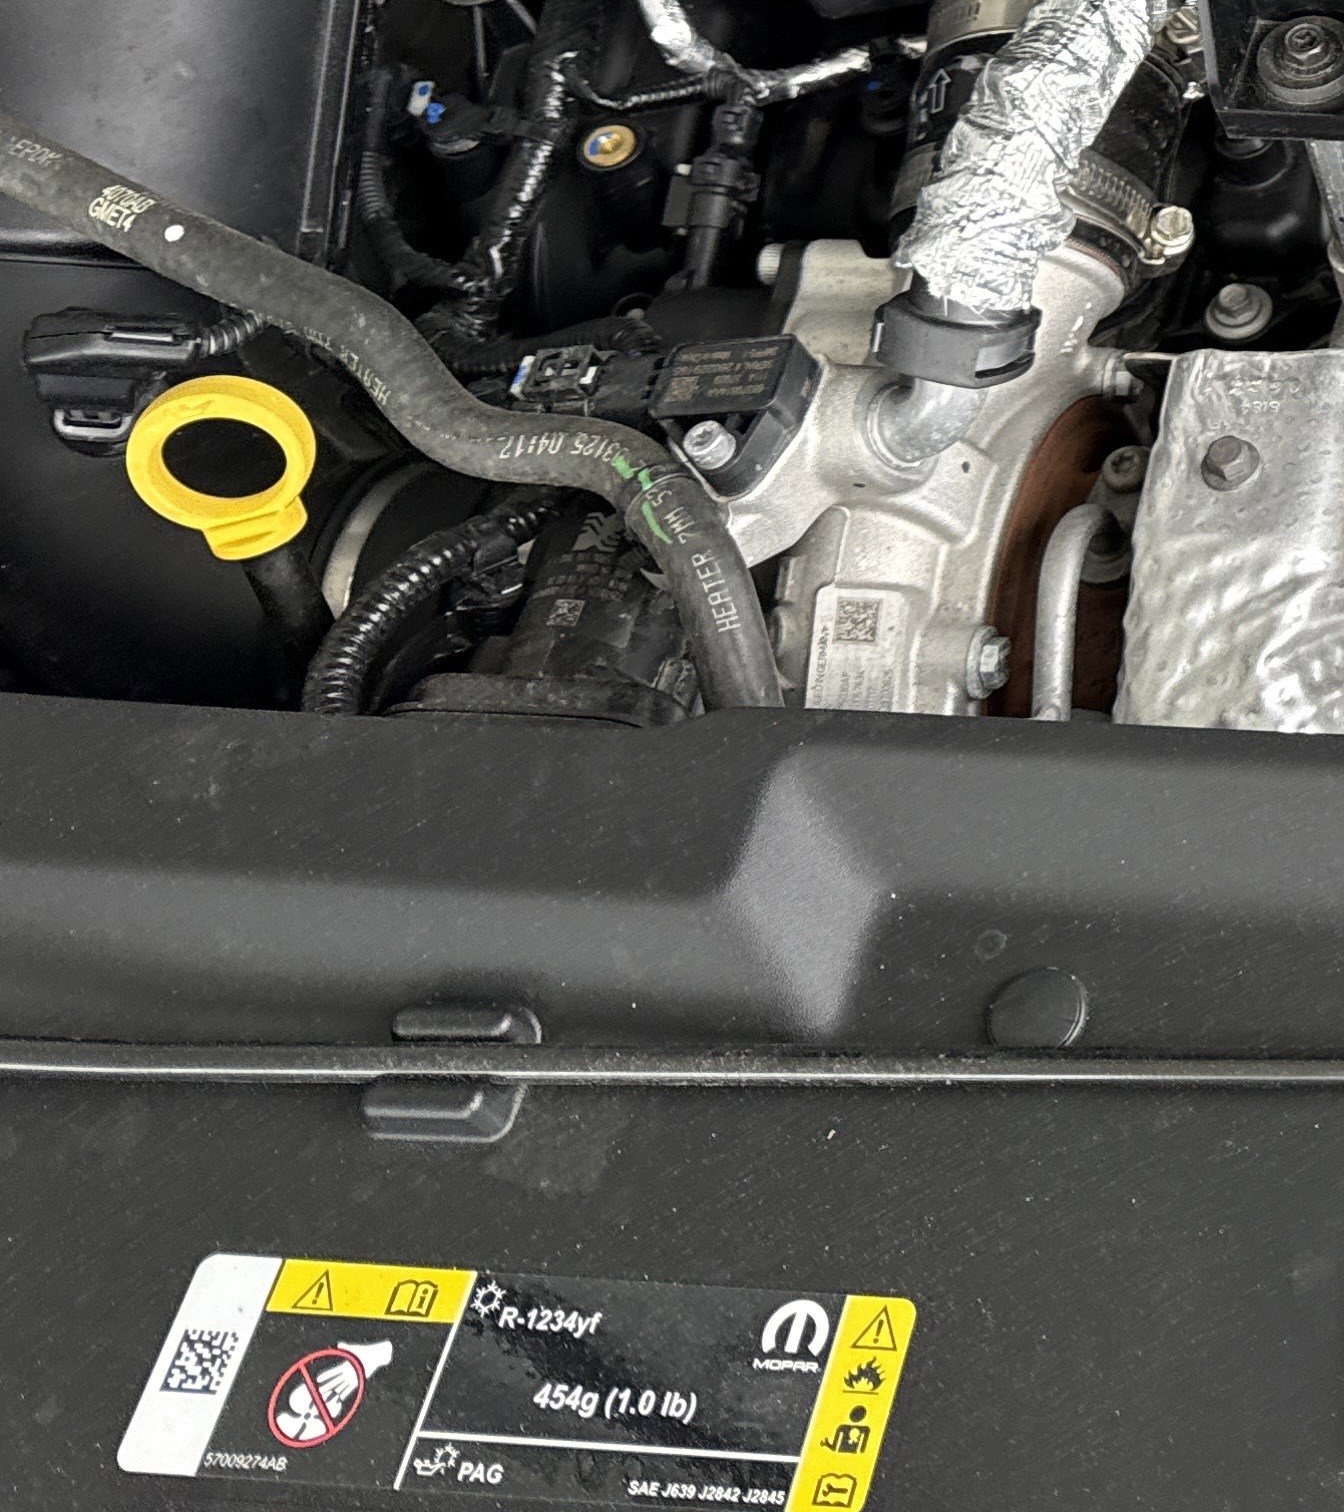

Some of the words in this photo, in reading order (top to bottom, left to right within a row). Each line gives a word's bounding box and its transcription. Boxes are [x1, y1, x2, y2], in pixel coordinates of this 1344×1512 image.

[690, 548, 742, 633] HEATER
[498, 1306, 602, 1339] R-1234yf
[752, 1357, 819, 1373] MOPAR
[533, 1383, 600, 1418] 454g
[603, 1387, 657, 1420] (1.0
[661, 1390, 697, 1425] lb)
[203, 1452, 288, 1472] 57009274AB
[457, 1462, 504, 1485] PAG
[627, 1479, 661, 1497] SAE
[661, 1482, 696, 1500] J639
[697, 1485, 742, 1503] J2842
[742, 1489, 786, 1506] J2845
